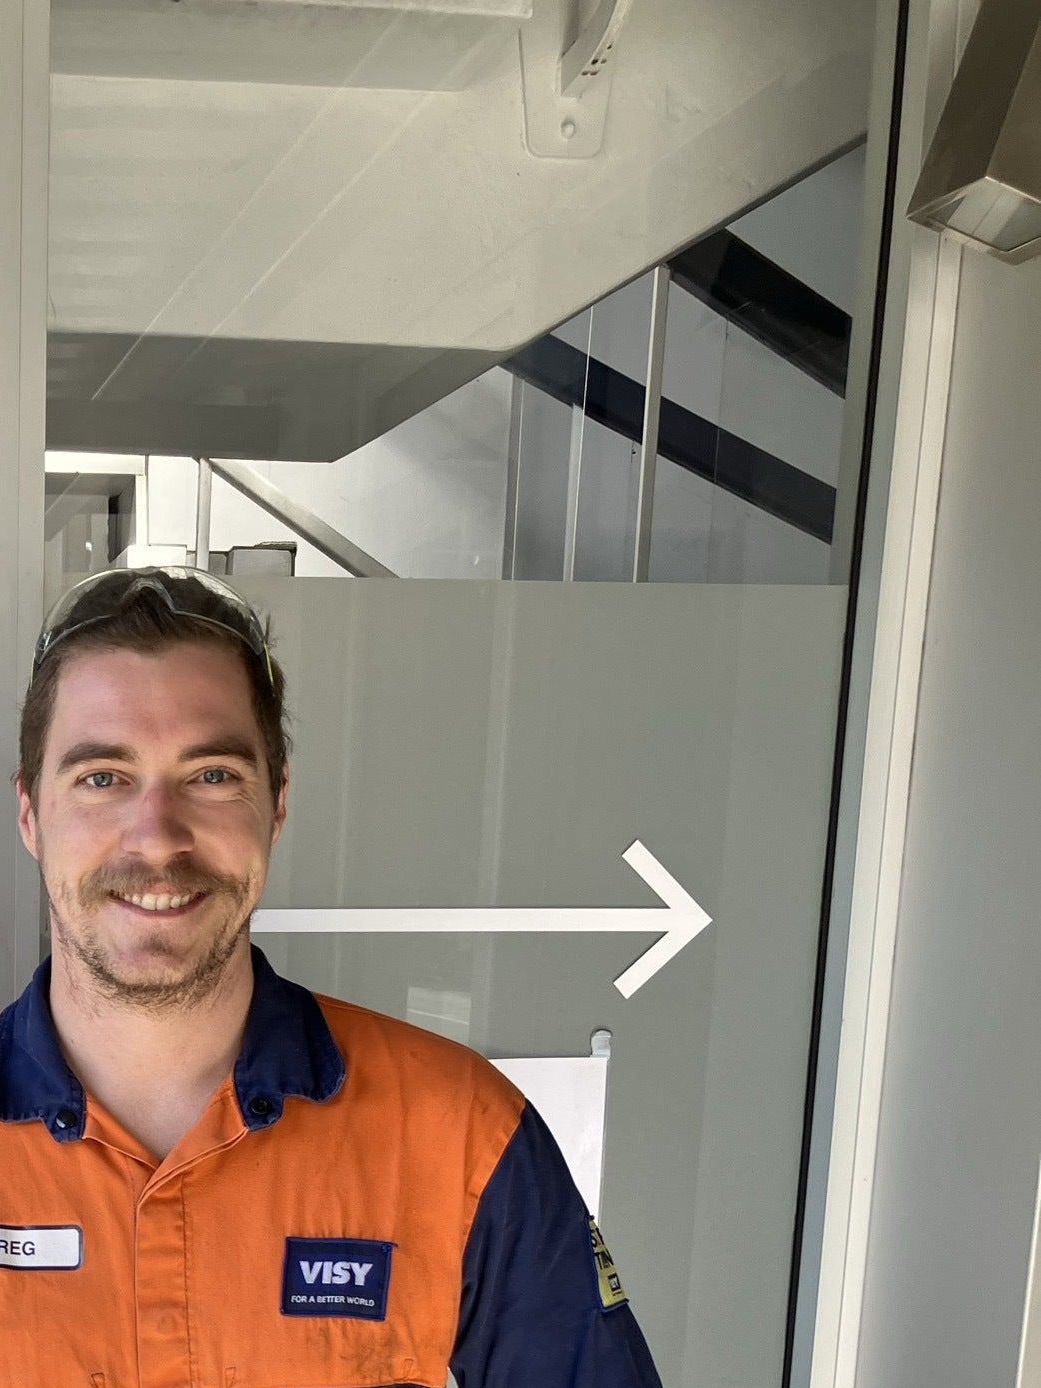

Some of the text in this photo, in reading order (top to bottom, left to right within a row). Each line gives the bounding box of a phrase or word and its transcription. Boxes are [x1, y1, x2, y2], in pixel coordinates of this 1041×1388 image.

[299, 1260, 373, 1286] VISY
[290, 1295, 375, 1306] FOR A BETTER WORLD
